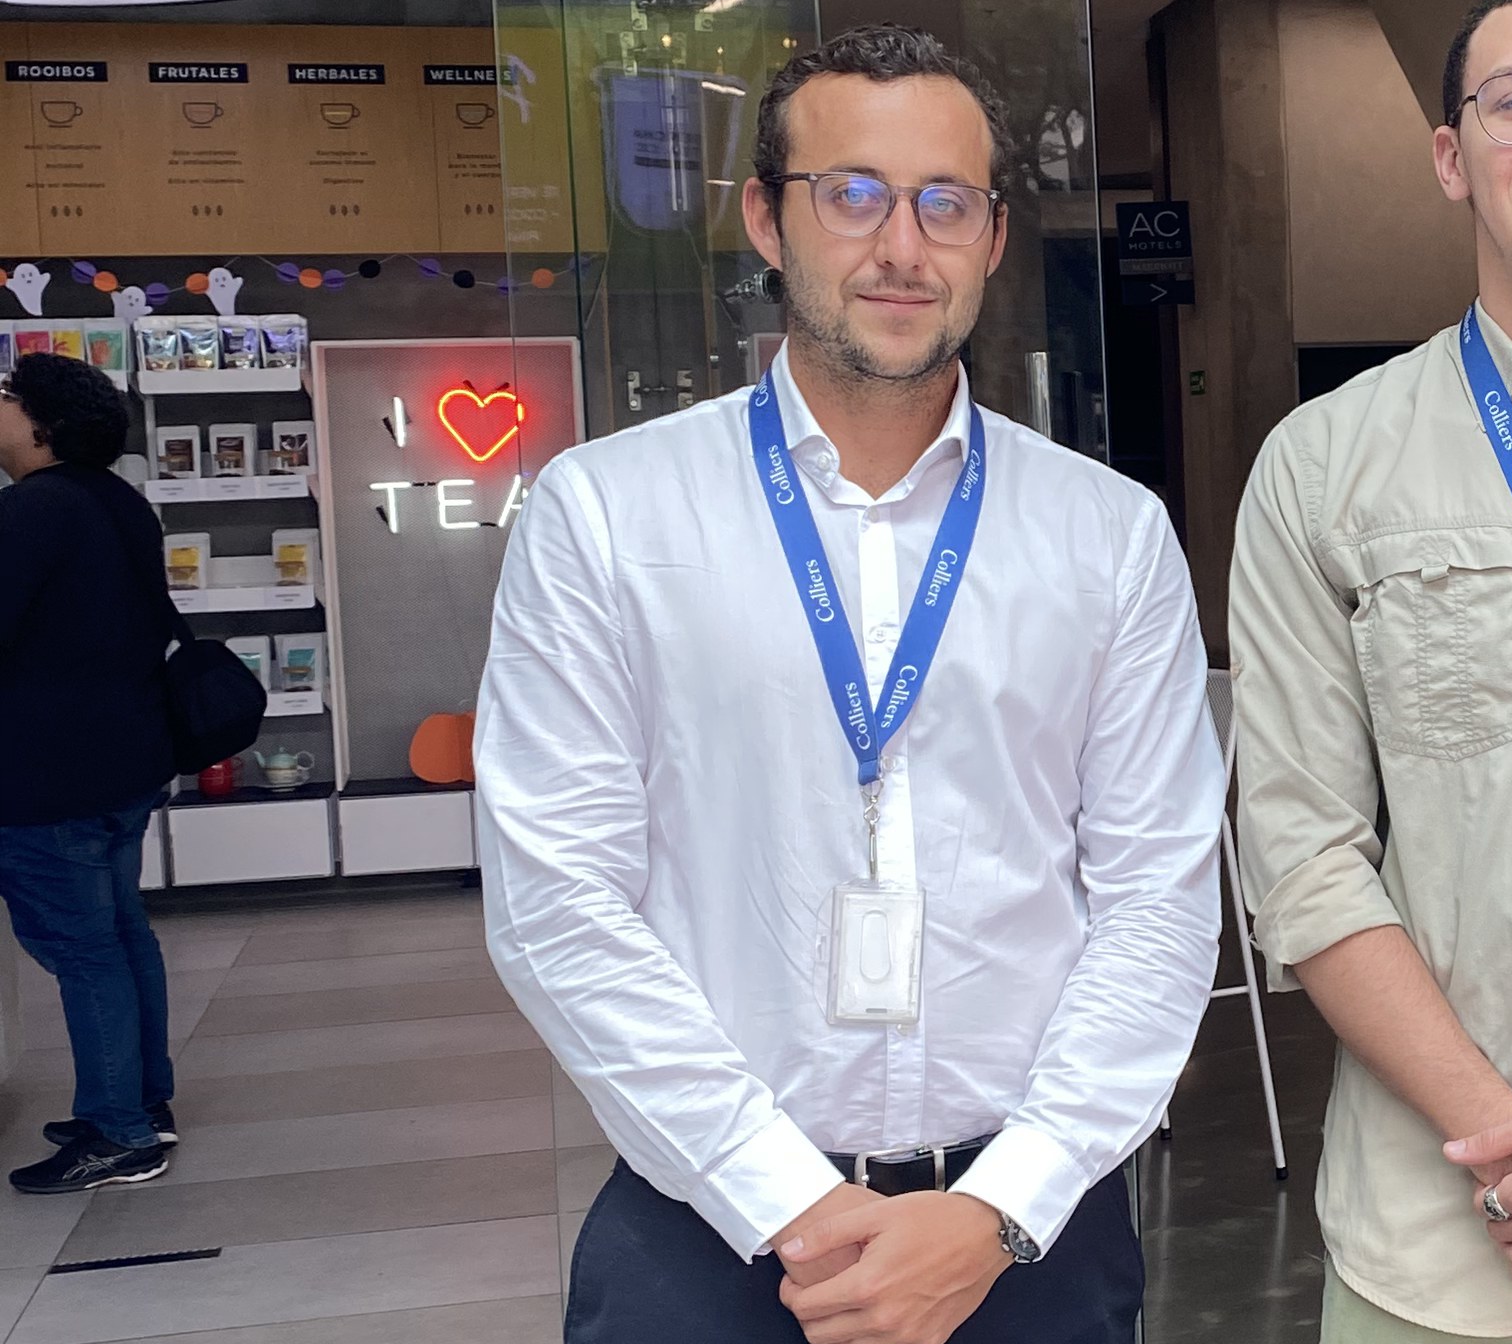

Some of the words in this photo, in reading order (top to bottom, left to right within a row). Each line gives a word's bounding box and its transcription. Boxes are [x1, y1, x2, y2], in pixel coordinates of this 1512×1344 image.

[18, 65, 96, 79] ROOIBOS
[158, 66, 240, 80] FRUTALES
[295, 67, 378, 81] HERBALES
[1128, 211, 1181, 238] AC
[1129, 242, 1182, 250] HOTELS
[767, 444, 795, 505] Colliers
[960, 449, 981, 502] Colliers
[805, 559, 835, 623] Colliers
[924, 549, 958, 607] Colliers
[845, 682, 871, 750] Colliers
[881, 664, 918, 729] Colliers
